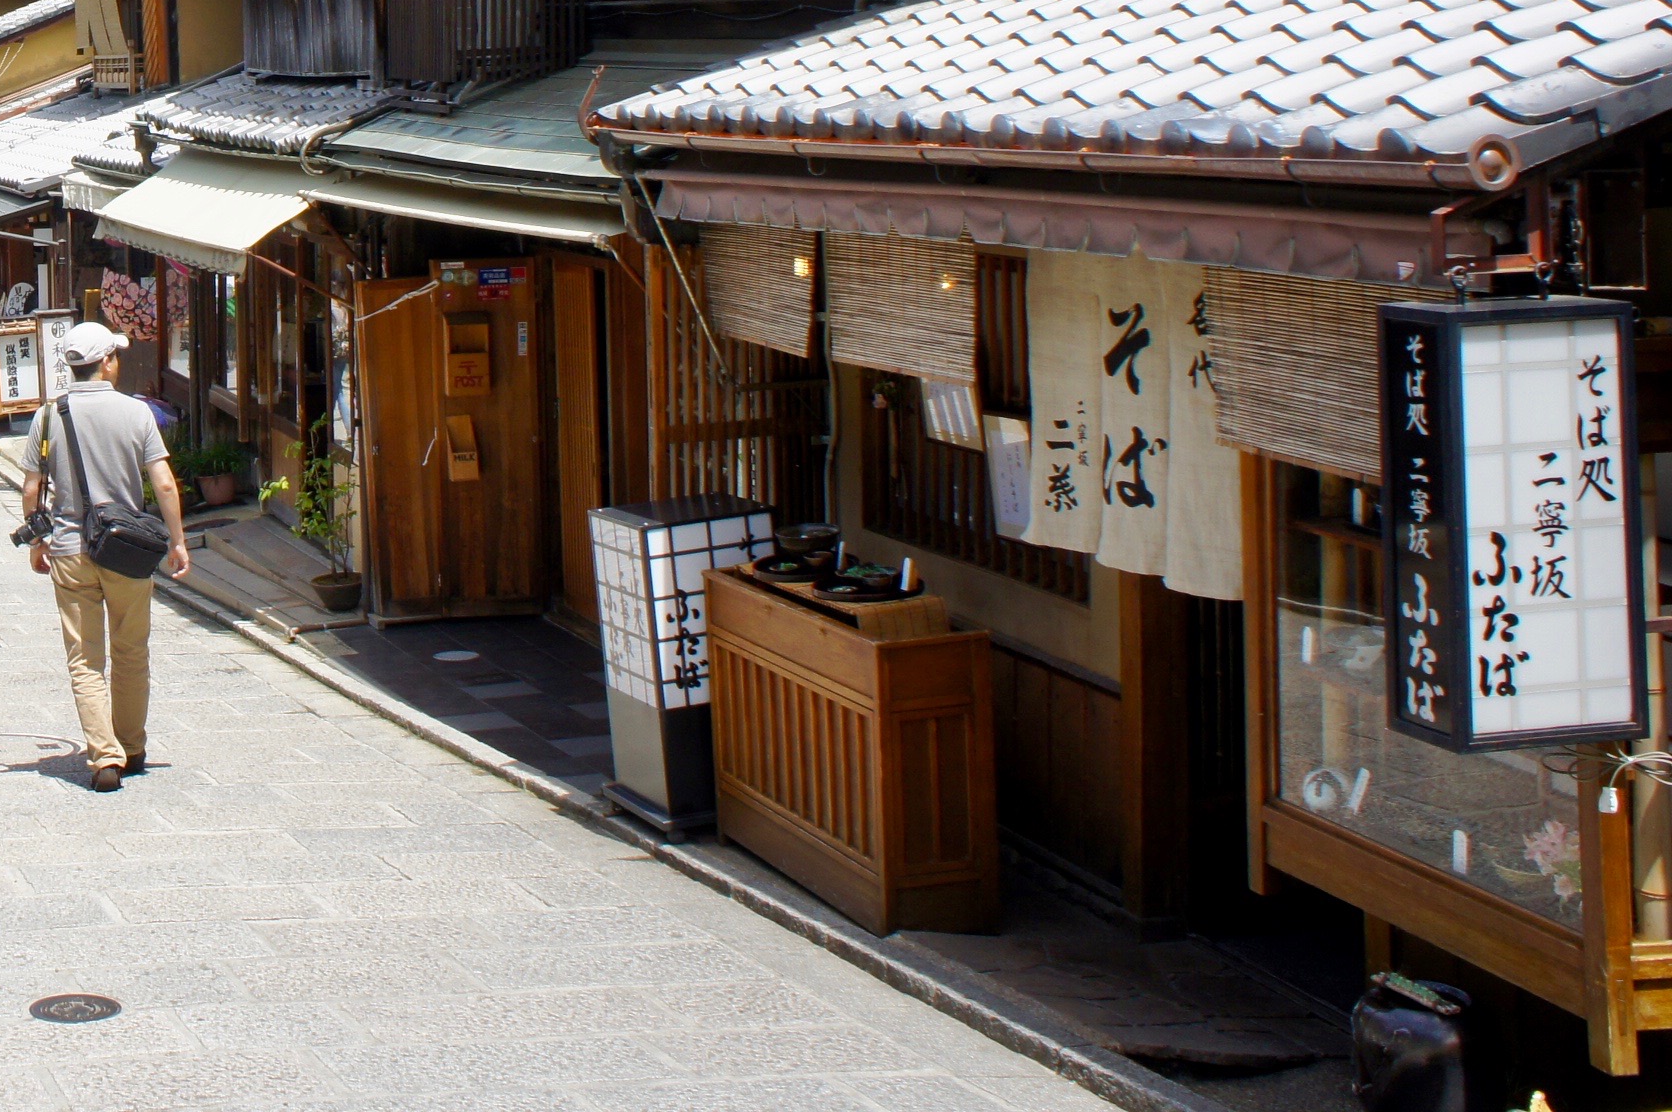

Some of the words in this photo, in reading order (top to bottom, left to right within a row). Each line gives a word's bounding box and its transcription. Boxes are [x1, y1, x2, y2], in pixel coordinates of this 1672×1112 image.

[52, 343, 68, 390] 和傘屋
[454, 376, 483, 388] POST
[1102, 303, 1167, 508] そば
[1406, 335, 1428, 436] そば処
[454, 453, 476, 462] MILK
[1576, 354, 1617, 503] そば処
[1407, 457, 1431, 559] 二寧坂
[1530, 451, 1572, 599] 二寧坂
[666, 588, 708, 689] ふたば
[1402, 573, 1445, 724] ふたば
[1472, 531, 1530, 697] ふたば
